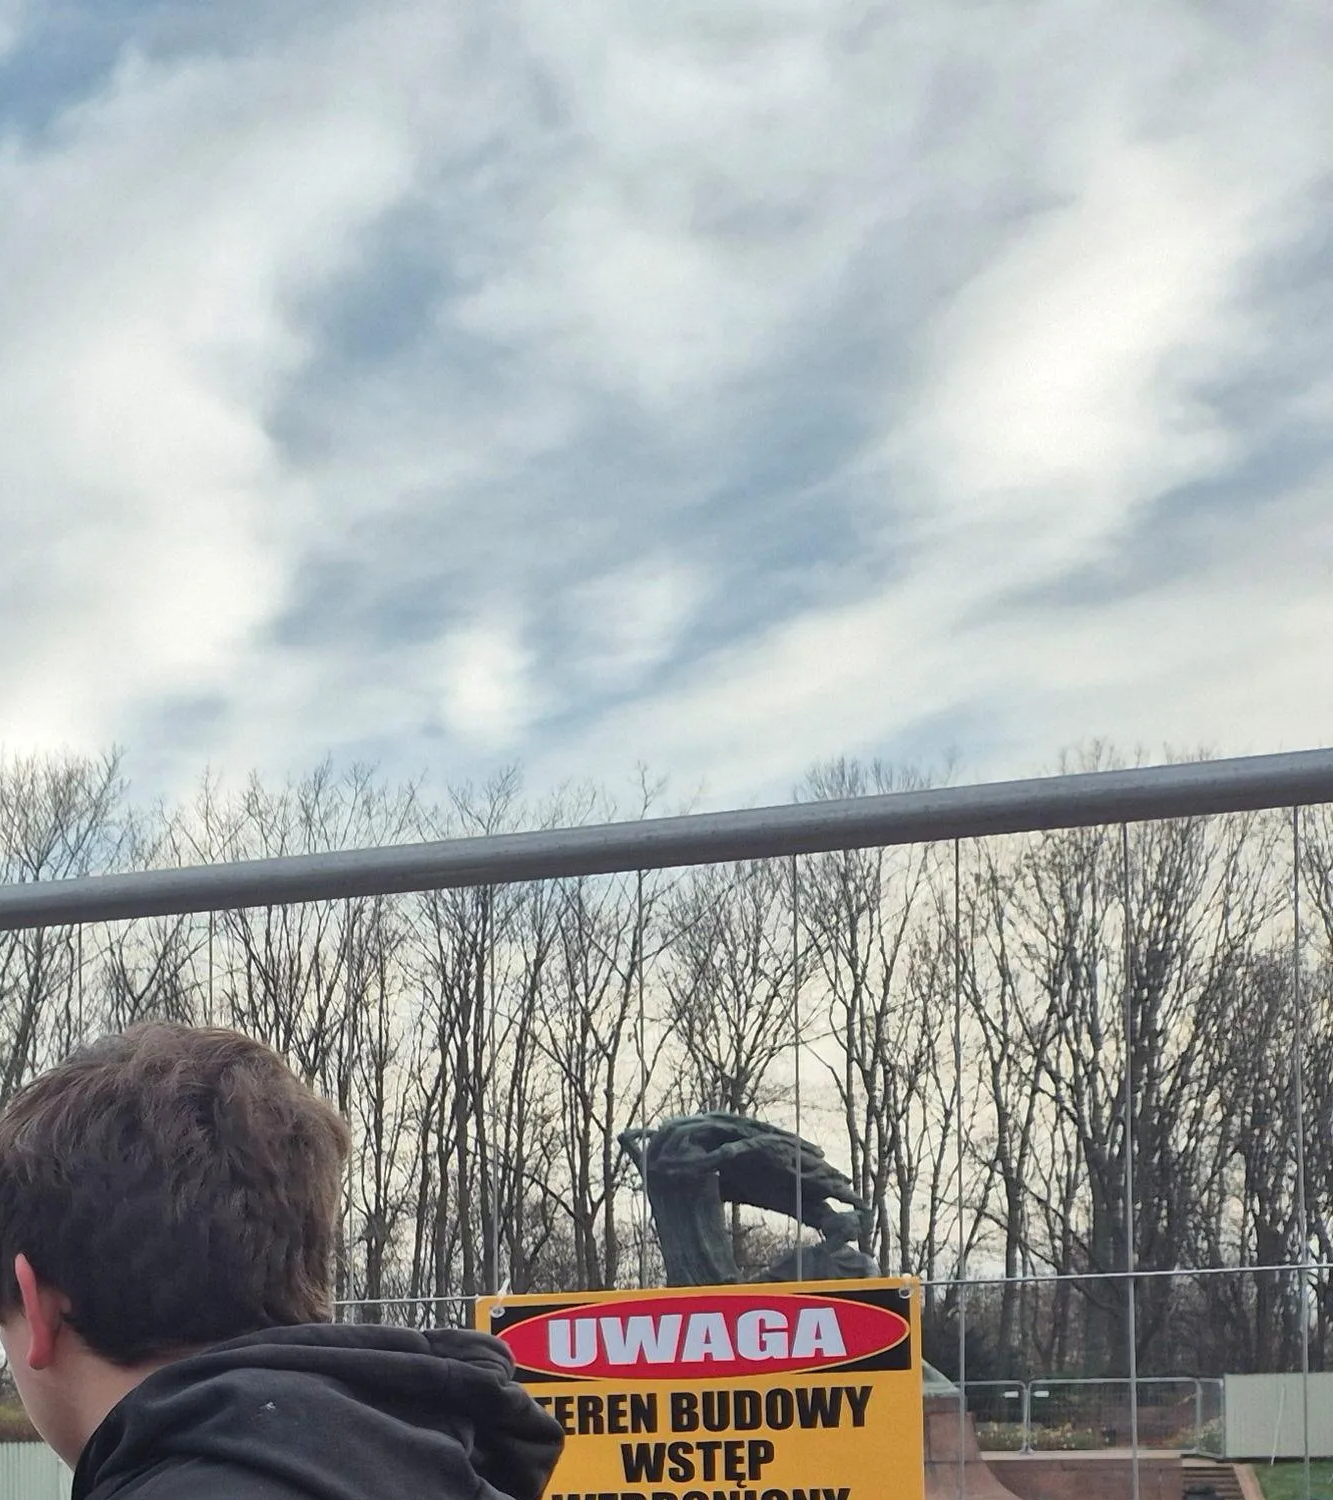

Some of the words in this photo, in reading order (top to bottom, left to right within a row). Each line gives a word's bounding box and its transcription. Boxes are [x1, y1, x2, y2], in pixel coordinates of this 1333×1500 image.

[547, 1307, 847, 1368] UWAGA
[671, 1385, 873, 1433] BUDOWY
[621, 1440, 775, 1488] WSTĘP
